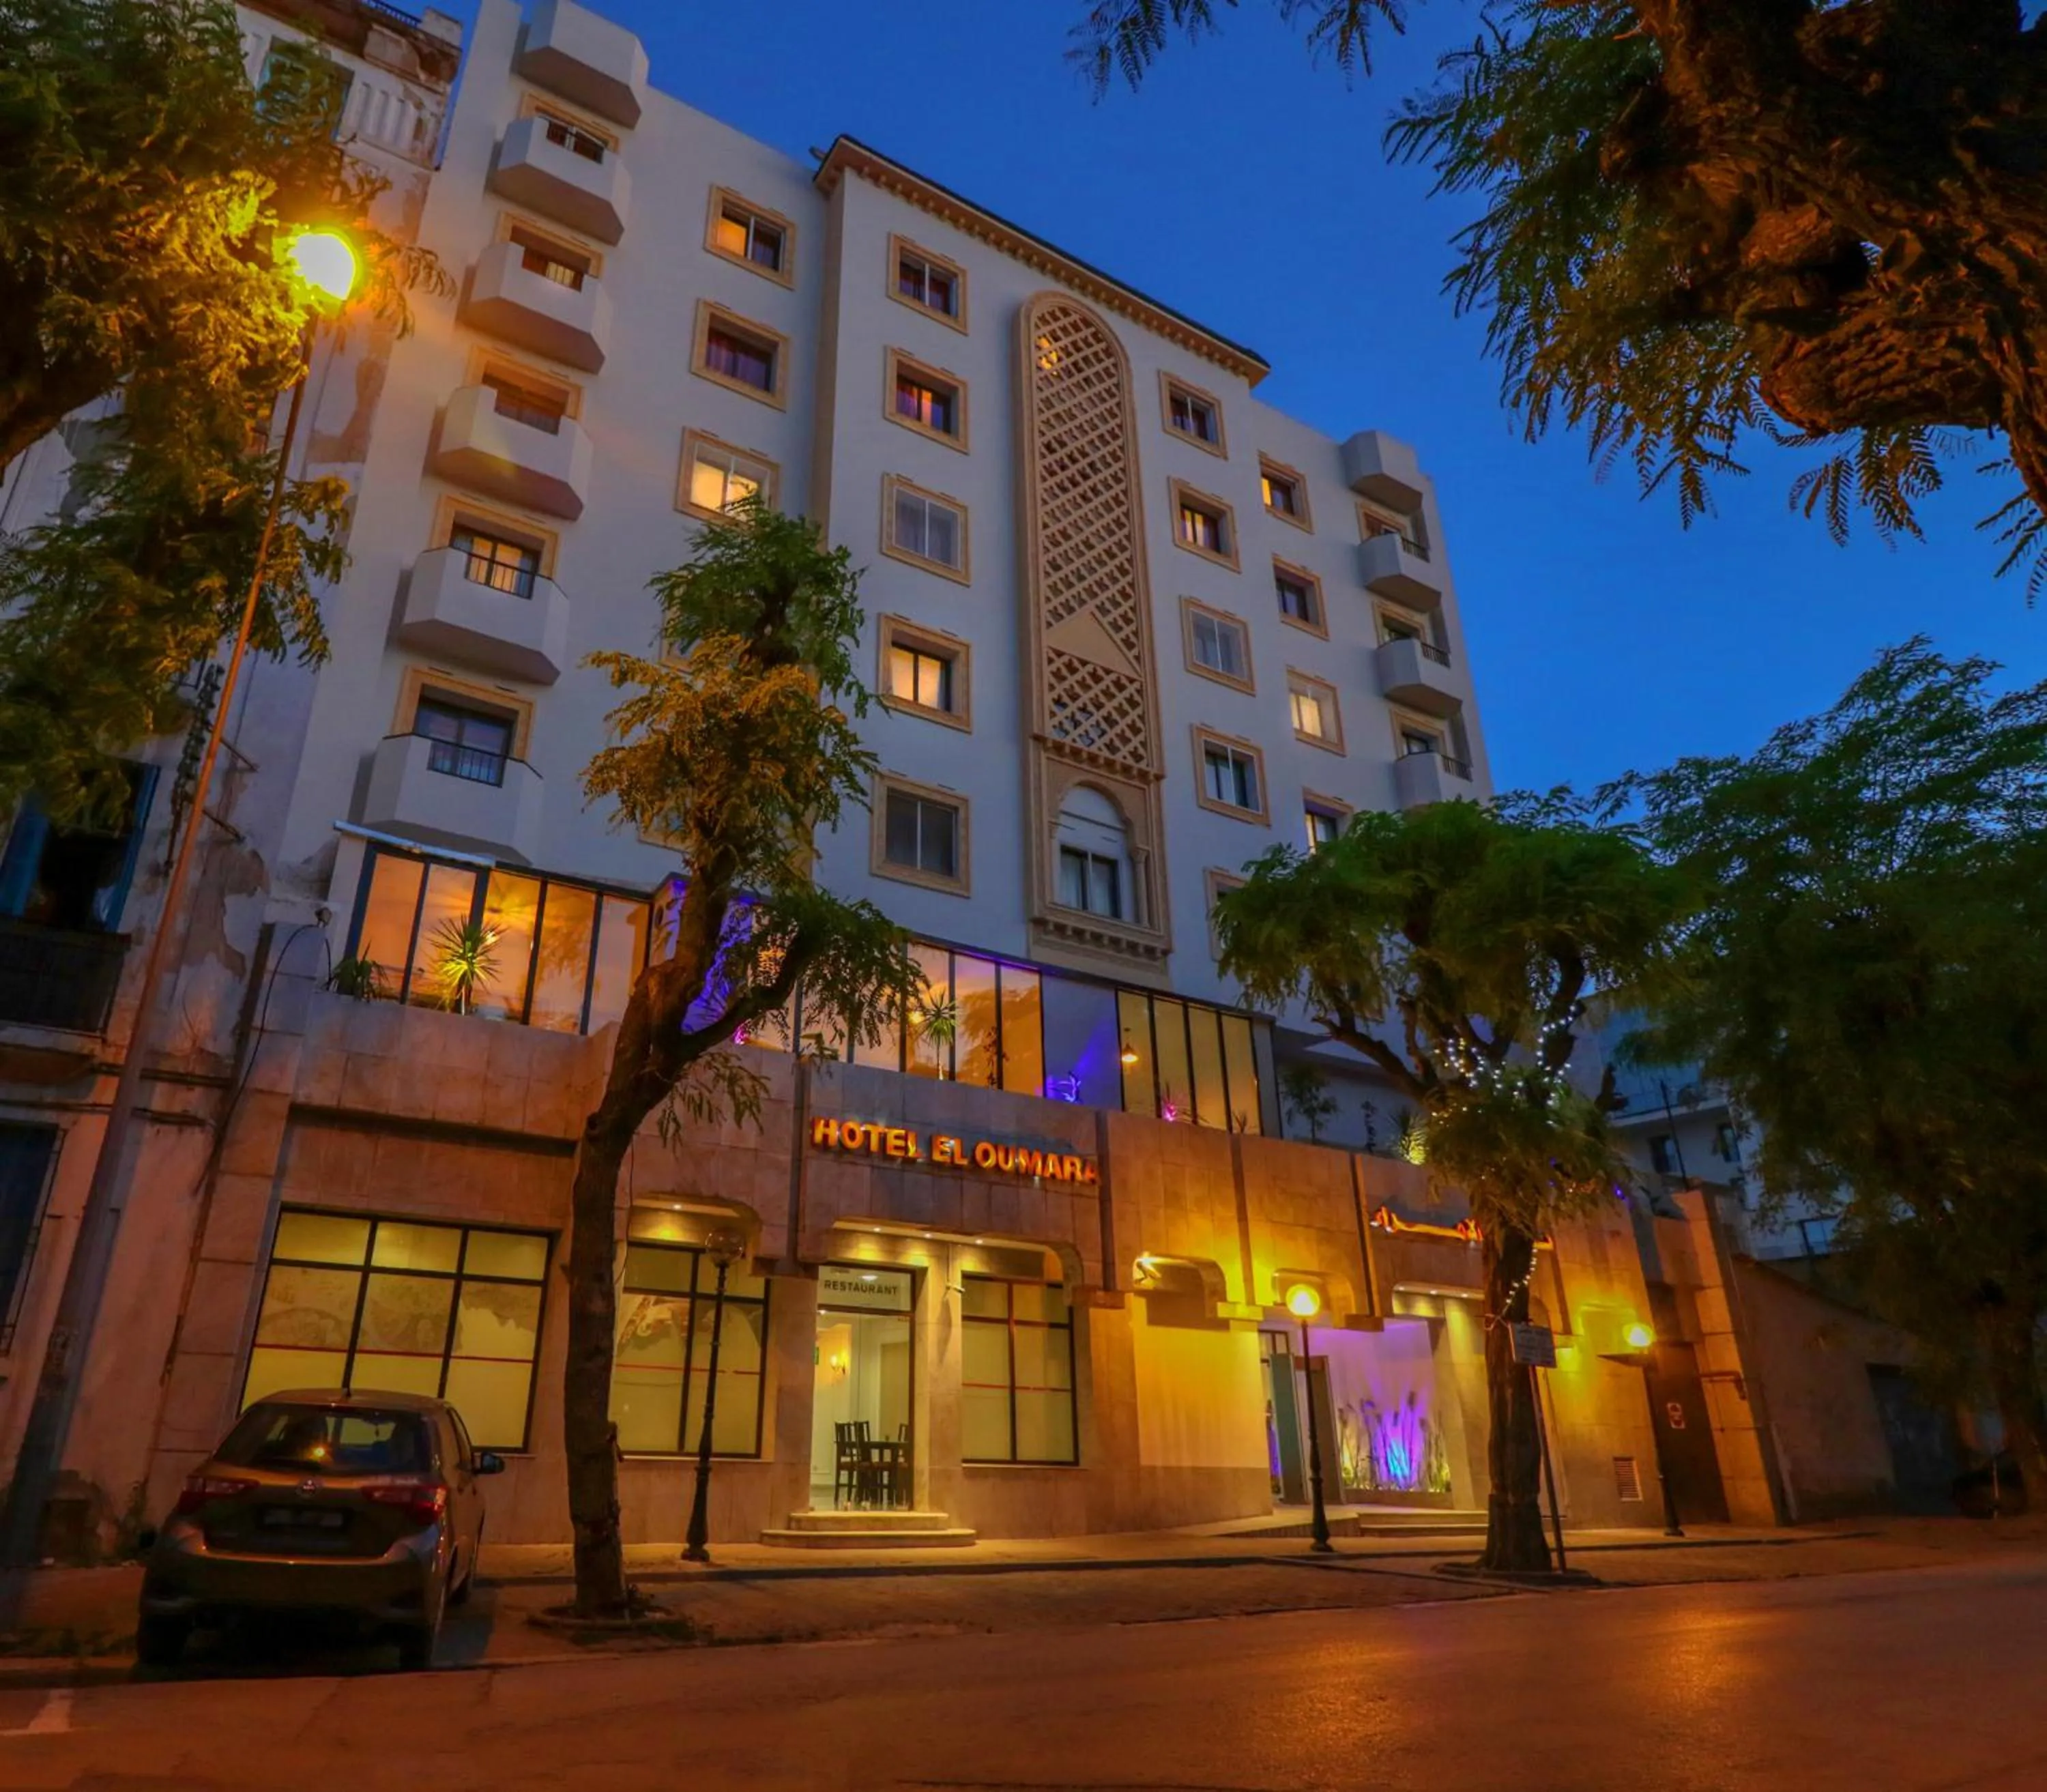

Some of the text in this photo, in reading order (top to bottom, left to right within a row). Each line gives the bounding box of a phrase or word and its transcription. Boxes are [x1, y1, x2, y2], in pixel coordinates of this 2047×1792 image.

[812, 1117, 923, 1158] HOTEL
[931, 1133, 968, 1166] EL
[824, 1279, 897, 1296] RESTAURANT
